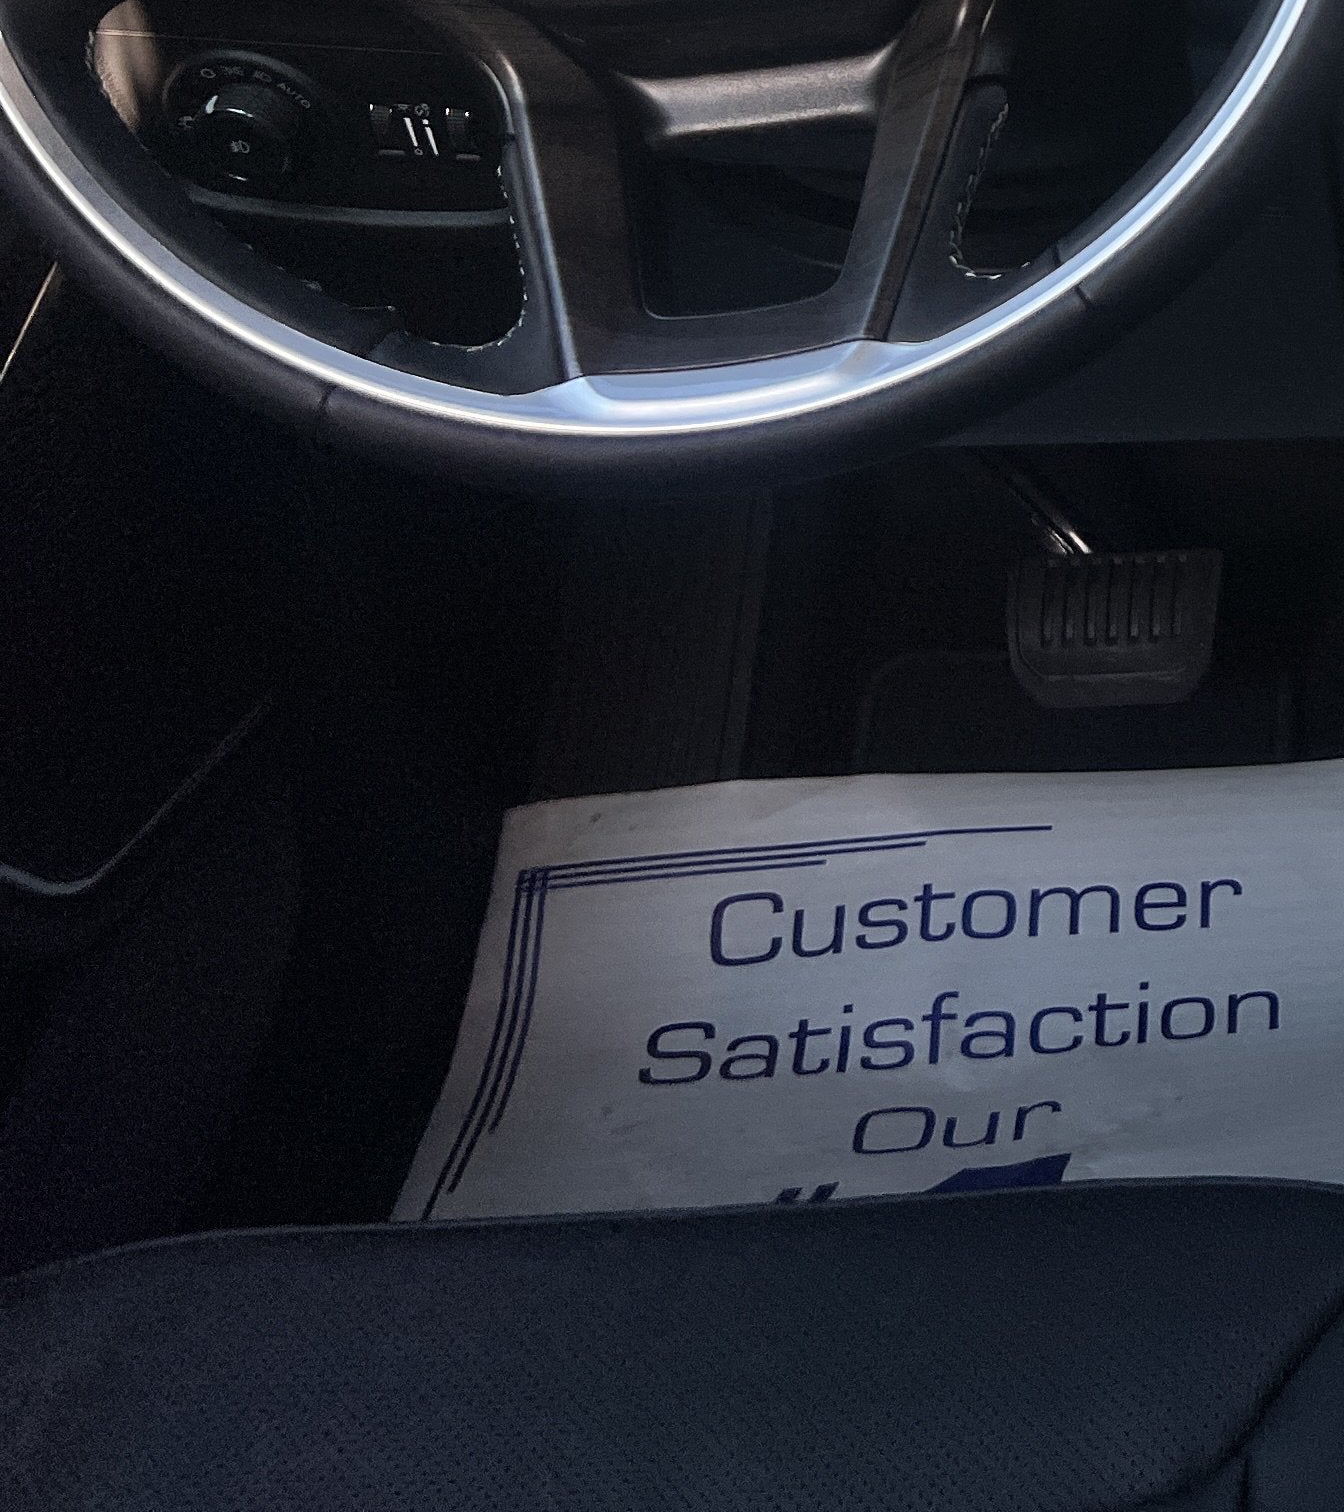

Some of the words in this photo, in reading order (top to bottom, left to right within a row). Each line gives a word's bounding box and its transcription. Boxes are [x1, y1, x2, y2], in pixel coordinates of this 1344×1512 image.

[707, 874, 1244, 970] Customer
[637, 981, 1283, 1087] Satisfaction
[850, 1099, 1063, 1156] Our
